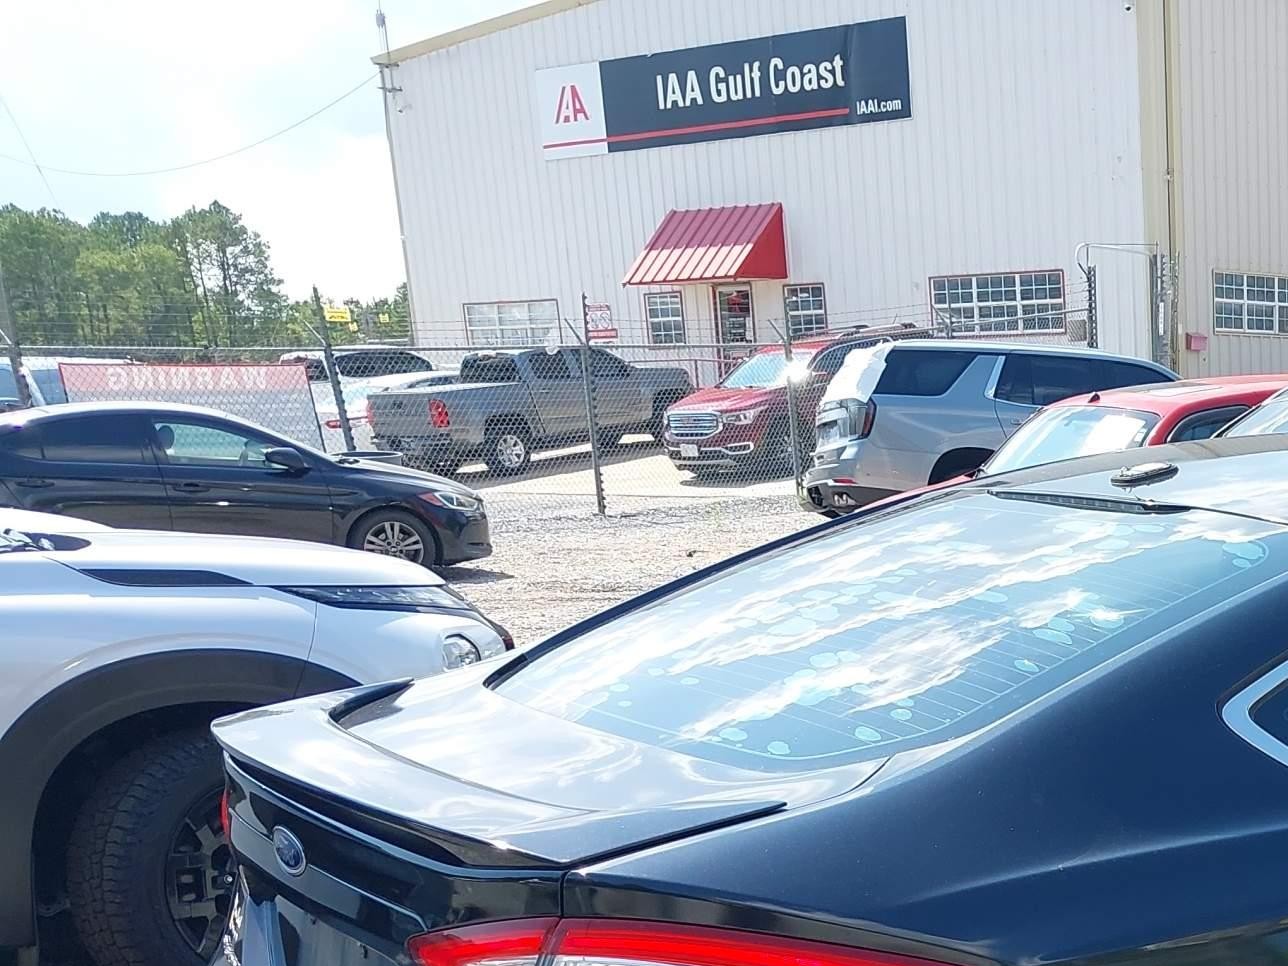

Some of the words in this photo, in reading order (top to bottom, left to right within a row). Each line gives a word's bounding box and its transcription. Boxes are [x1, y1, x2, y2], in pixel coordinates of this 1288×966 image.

[656, 70, 704, 110] IAA
[709, 61, 761, 103] Gulf
[769, 54, 845, 95] Coast
[856, 99, 902, 115] IAAI.com
